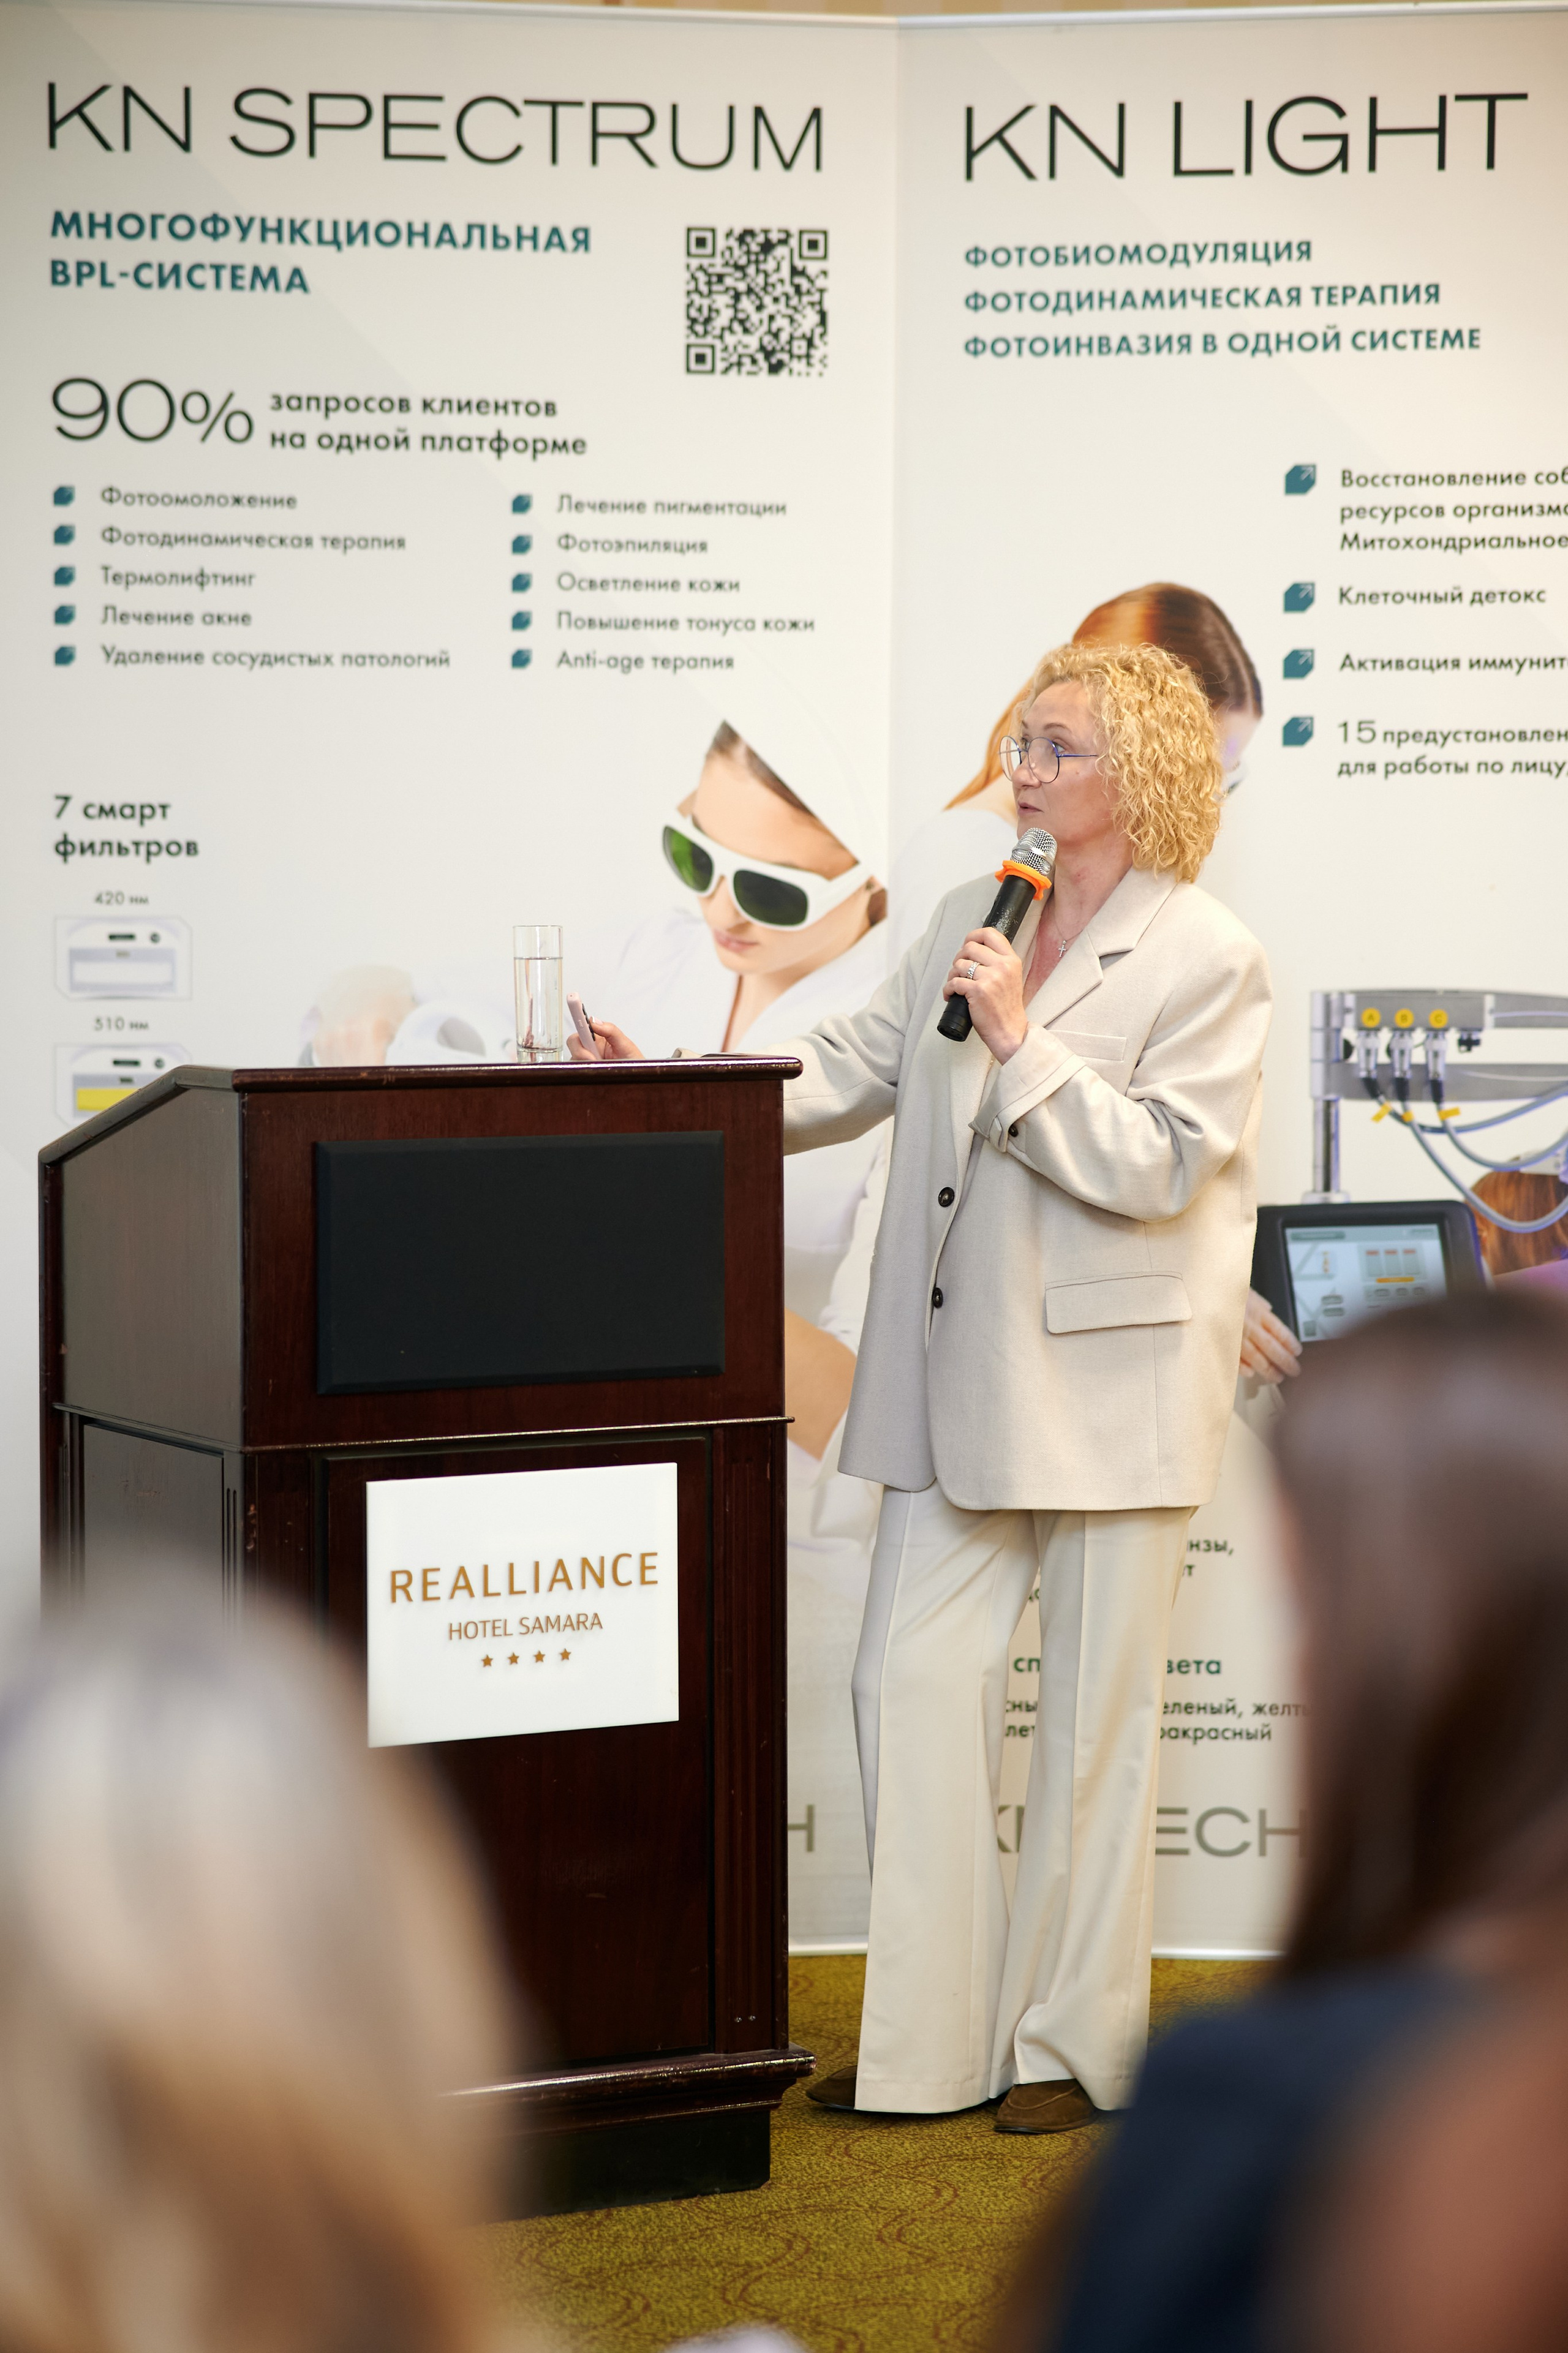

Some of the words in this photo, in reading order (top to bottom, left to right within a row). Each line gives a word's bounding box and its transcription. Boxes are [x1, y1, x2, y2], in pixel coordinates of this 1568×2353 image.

[47, 81, 191, 153] KN
[228, 86, 823, 172] SPECTRUM
[965, 102, 1126, 182] KN
[1173, 92, 1529, 177] LIGHT
[50, 209, 590, 252] МНОГОФУНКЦИОНАЛЬНАЯ
[965, 240, 1311, 268] ФОТОБИОМОДУЛЯЦИЯ
[965, 286, 1302, 315] ФОТОДИНАМИЧЕСКАЯ
[1311, 283, 1440, 306] ТЕРАПИЯ
[964, 334, 1191, 358] ФОТОИНВАЗИЯ
[1202, 333, 1218, 354] В
[1227, 325, 1341, 357] ОДНОЙ
[1351, 328, 1480, 351] СИСТЕМЕ
[51, 377, 254, 444] 90%
[270, 394, 411, 420] запросов
[421, 397, 557, 417] клиентов
[270, 432, 306, 449] на
[316, 427, 410, 454] одной
[420, 429, 587, 462] платформе
[1341, 469, 1527, 488] Восстановление
[100, 484, 297, 510] Фотоомоложение
[557, 493, 647, 514] Лечение
[653, 501, 786, 518] пигментации
[1340, 505, 1446, 525] ресурсов
[100, 525, 314, 549] Фотодинамическая
[320, 535, 406, 555] терапия
[556, 532, 708, 555] Фотоэпиляция
[1340, 532, 1568, 555] Митохондриальное
[100, 564, 255, 592] Термолифтинг
[556, 571, 681, 592] Осветление
[688, 579, 740, 592] кожи
[1338, 586, 1463, 605] Клеточный
[1469, 590, 1546, 606] детокс
[101, 604, 194, 625] Лечение
[201, 612, 252, 627] акне
[557, 609, 680, 631] Повышение
[685, 617, 756, 637] тонуса
[763, 619, 815, 632] кожи
[100, 644, 205, 667] Удаление
[211, 651, 334, 671] сосудистых
[341, 650, 450, 668] патологий
[556, 650, 644, 675] Anti-age
[650, 656, 734, 675] терапия
[1340, 653, 1461, 674] Активация
[1468, 657, 1567, 676] иммунит
[1338, 720, 1377, 744] 15
[1382, 729, 1568, 749] предустановлен
[1337, 762, 1376, 778] для
[1384, 754, 1469, 780] работы
[1476, 761, 1504, 774] по
[55, 794, 72, 819] 7
[82, 802, 170, 827] смарт
[54, 832, 199, 864] фильтров
[94, 890, 125, 906] 420
[94, 1015, 126, 1032] 510
[1186, 1539, 1234, 1556] нзы,
[390, 1552, 658, 1604] REALLIANCE
[448, 1618, 513, 1641] HOTEL
[518, 1612, 603, 1636] SAMARA
[1155, 1806, 1310, 1858] ECH
